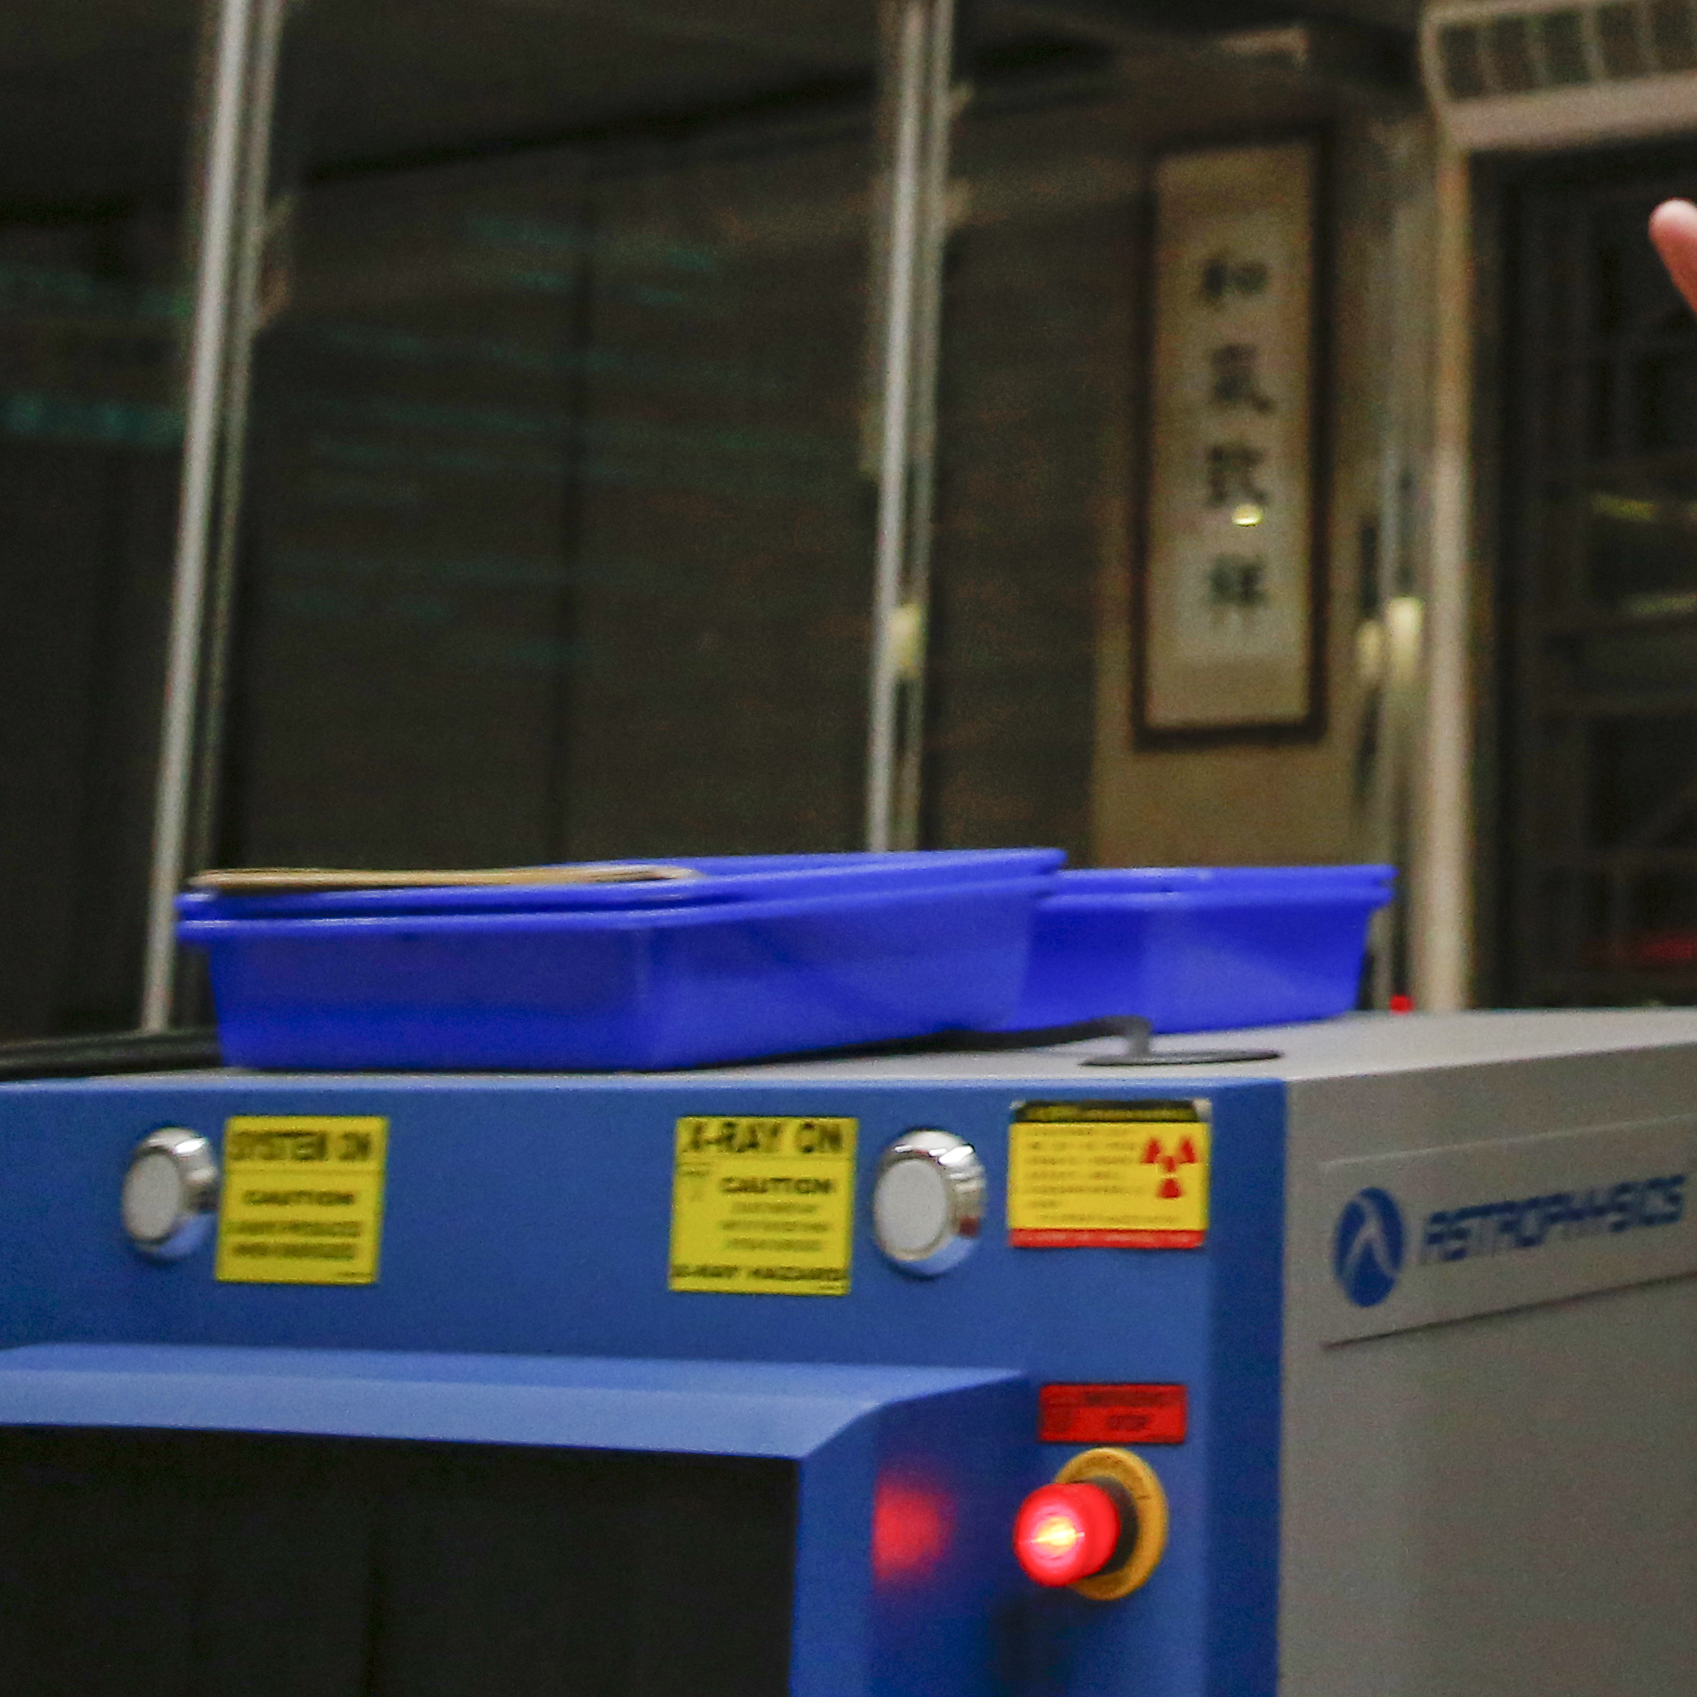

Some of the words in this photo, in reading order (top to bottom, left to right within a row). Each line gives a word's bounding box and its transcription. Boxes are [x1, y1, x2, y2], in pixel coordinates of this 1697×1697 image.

[229, 1129, 328, 1163] SYSTEM
[337, 1129, 373, 1163] ON
[683, 1119, 782, 1154] X-RAY
[794, 1120, 844, 1154] ON
[243, 1188, 355, 1206] CAUTION
[720, 1176, 836, 1196] CAUTION
